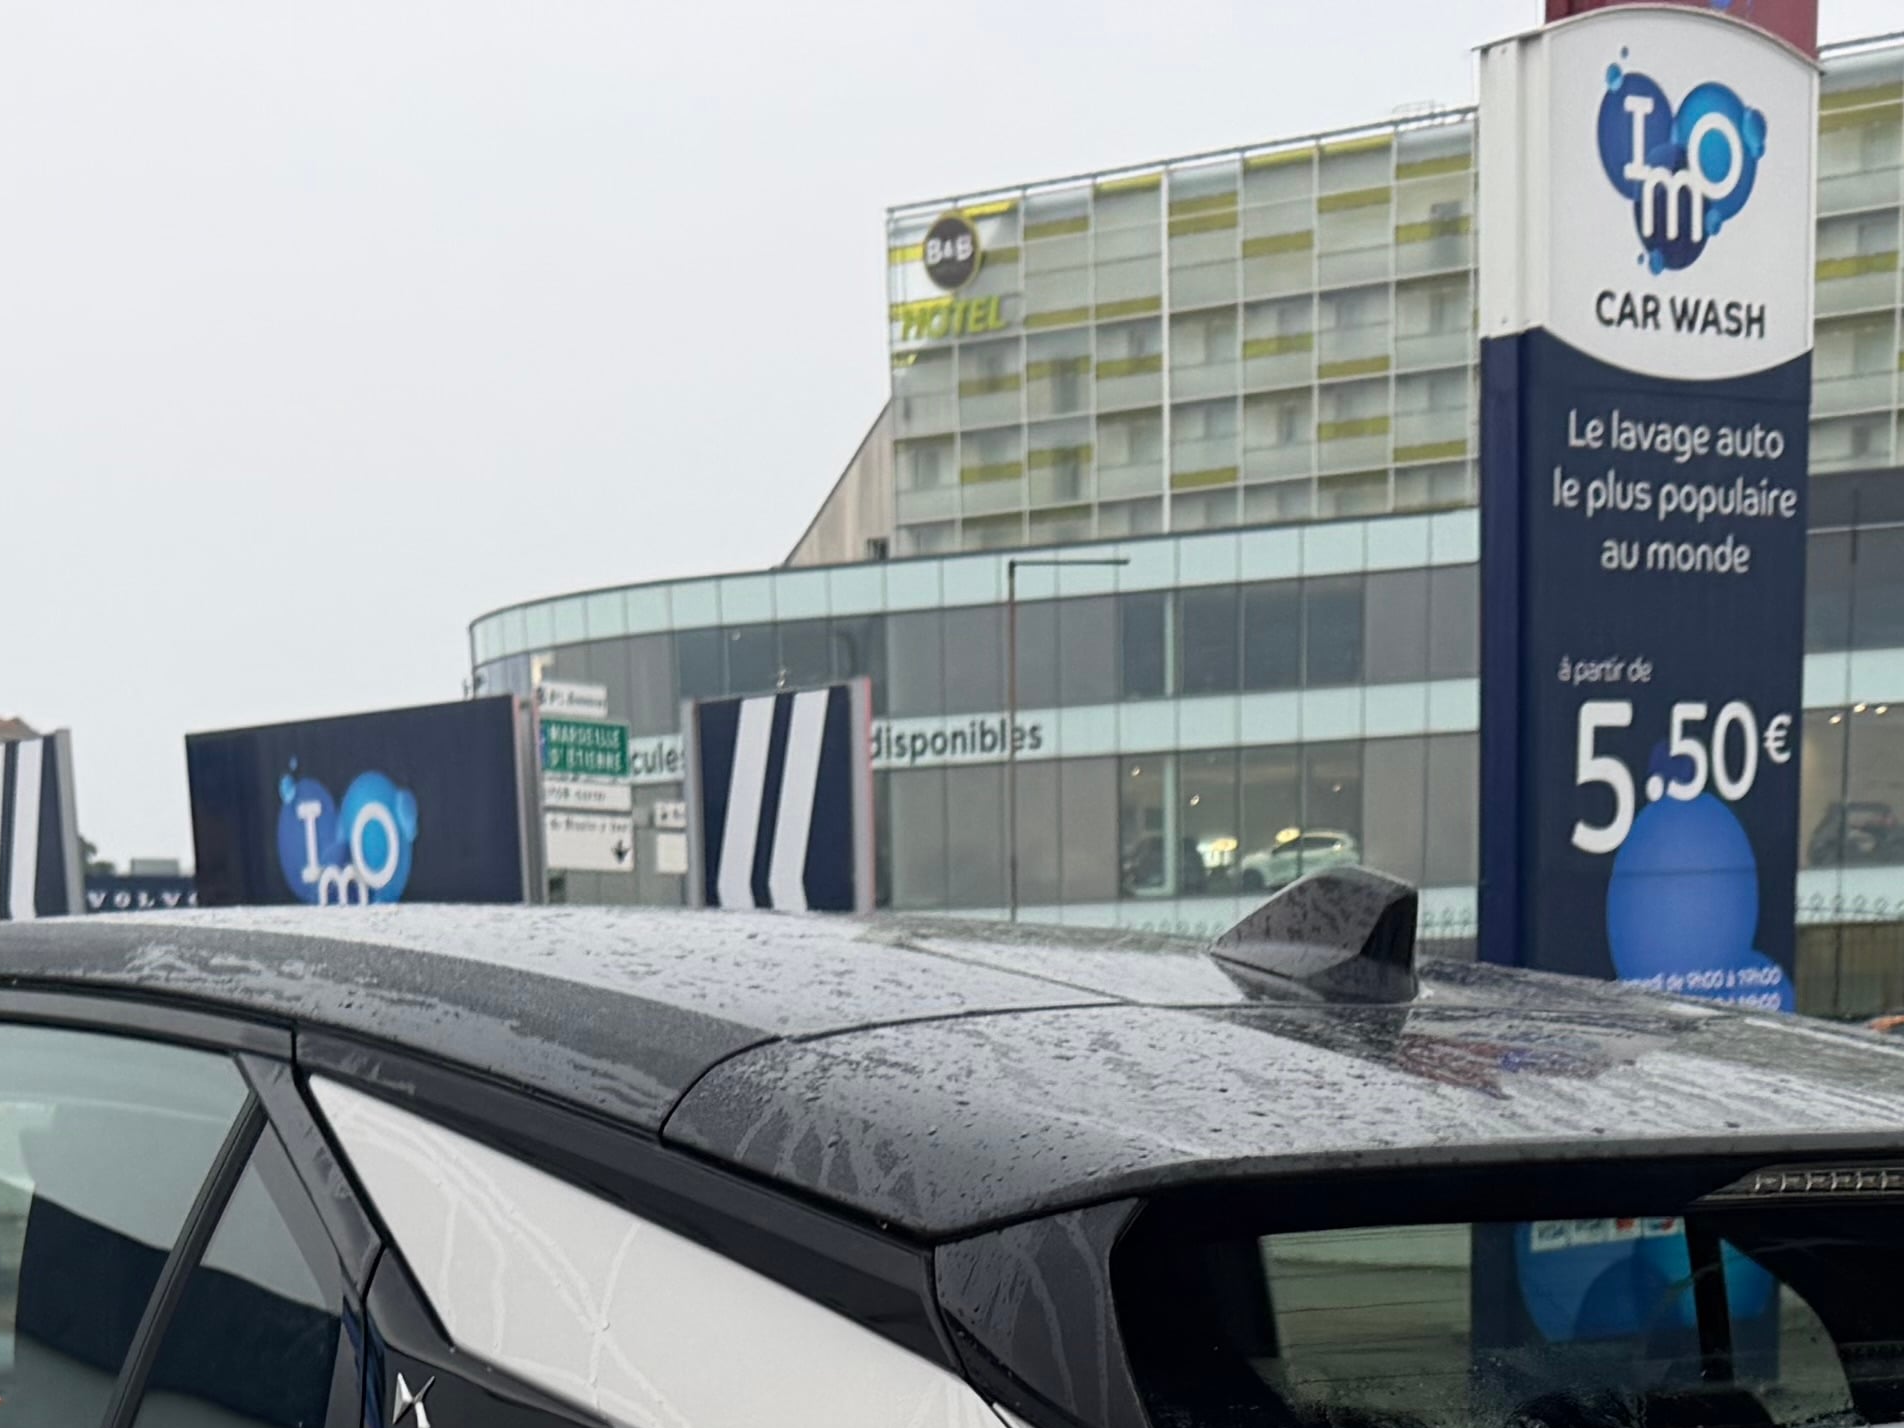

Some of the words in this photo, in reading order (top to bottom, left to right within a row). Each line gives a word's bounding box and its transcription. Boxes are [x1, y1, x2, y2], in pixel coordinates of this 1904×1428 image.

[900, 294, 1007, 342] HOTEL
[1596, 289, 1662, 332] CAR
[1669, 295, 1766, 340] WASH
[1568, 407, 1605, 449] Le
[1611, 408, 1712, 464] lavage
[1715, 422, 1785, 460] auto
[1552, 464, 1581, 508] le
[1585, 467, 1653, 518] plus
[1657, 476, 1798, 523] populaire
[1600, 538, 1640, 570] au
[1646, 532, 1751, 574] monde
[1557, 655, 1572, 683] à
[1573, 656, 1627, 687] partir
[1627, 656, 1653, 683] de
